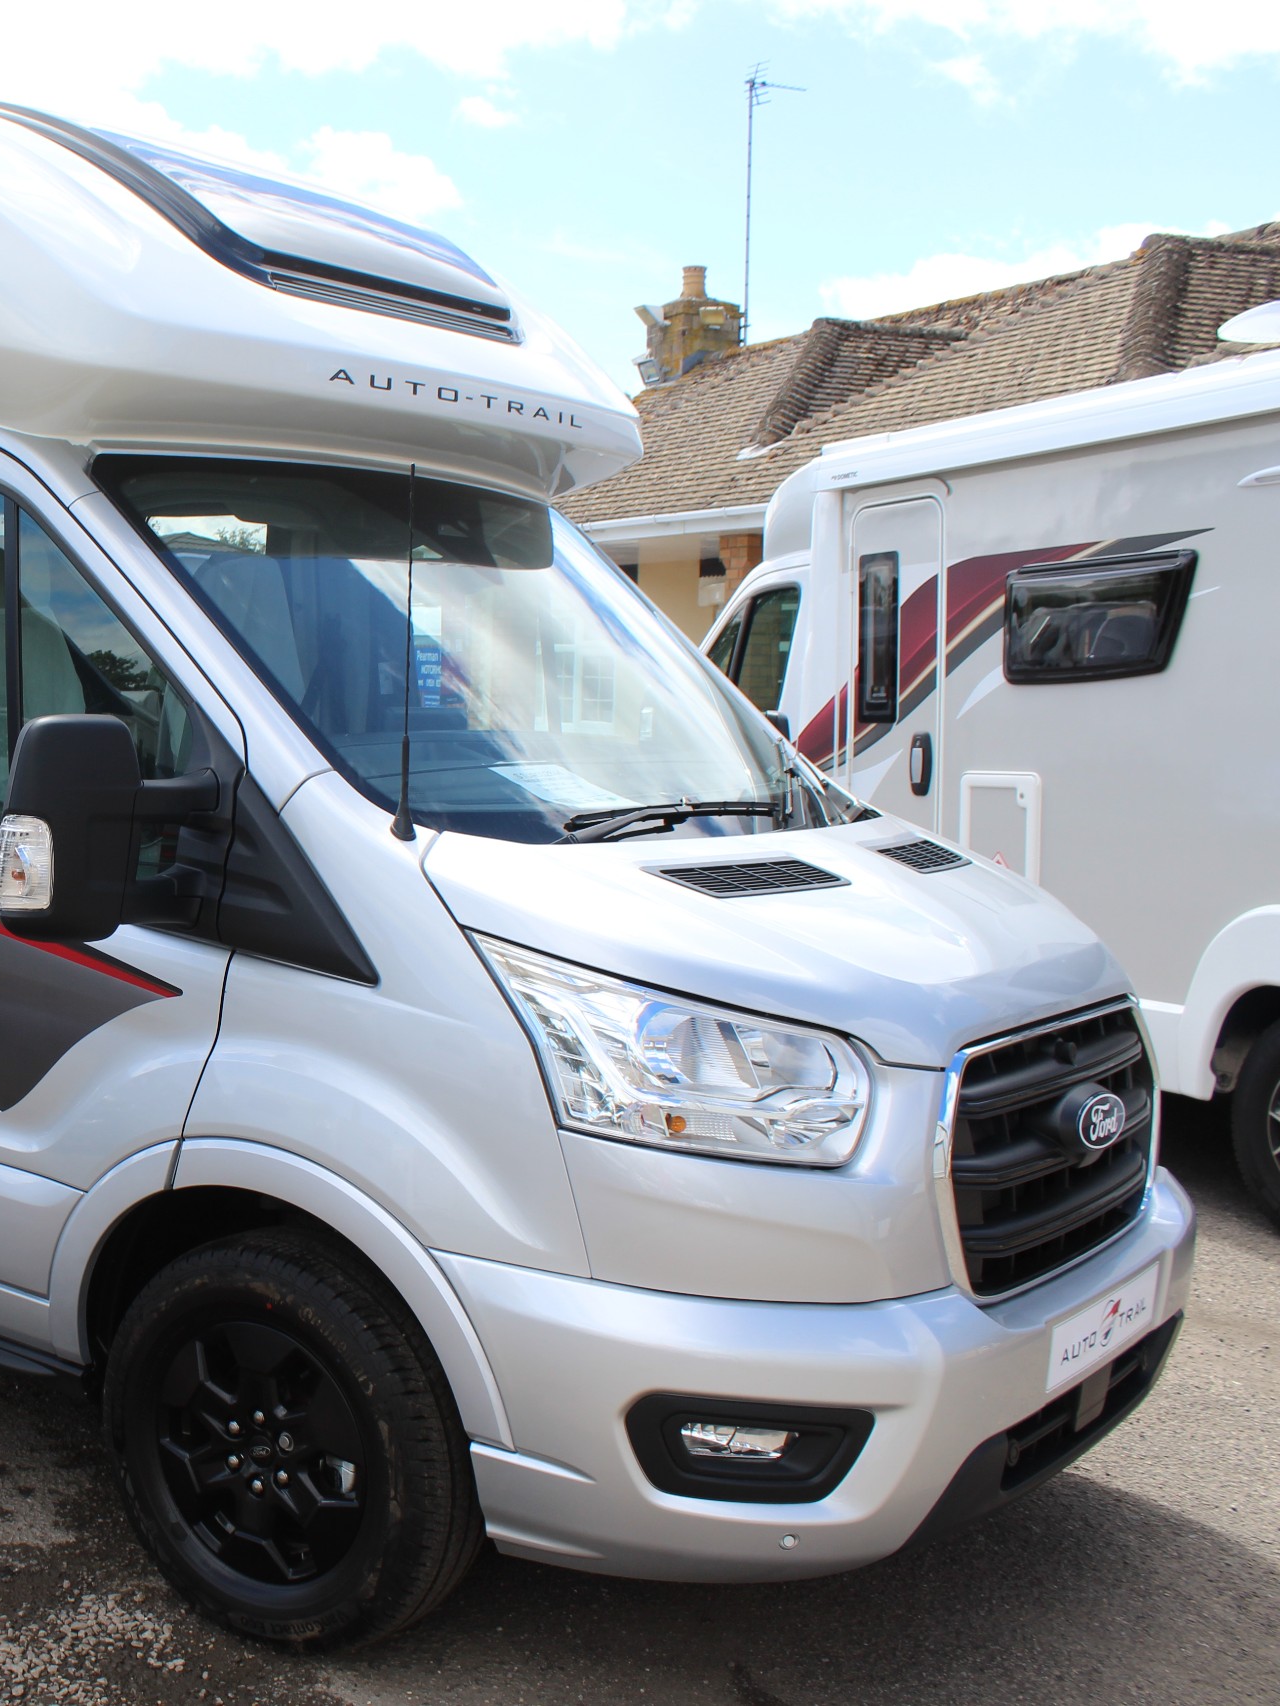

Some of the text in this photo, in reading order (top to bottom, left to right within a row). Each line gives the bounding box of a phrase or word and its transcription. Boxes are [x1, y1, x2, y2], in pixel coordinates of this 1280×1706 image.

[328, 368, 583, 429] AUTO-TRAIL
[1089, 1102, 1119, 1142] Ford
[1060, 1297, 1147, 1366] AUTO TRAIL
